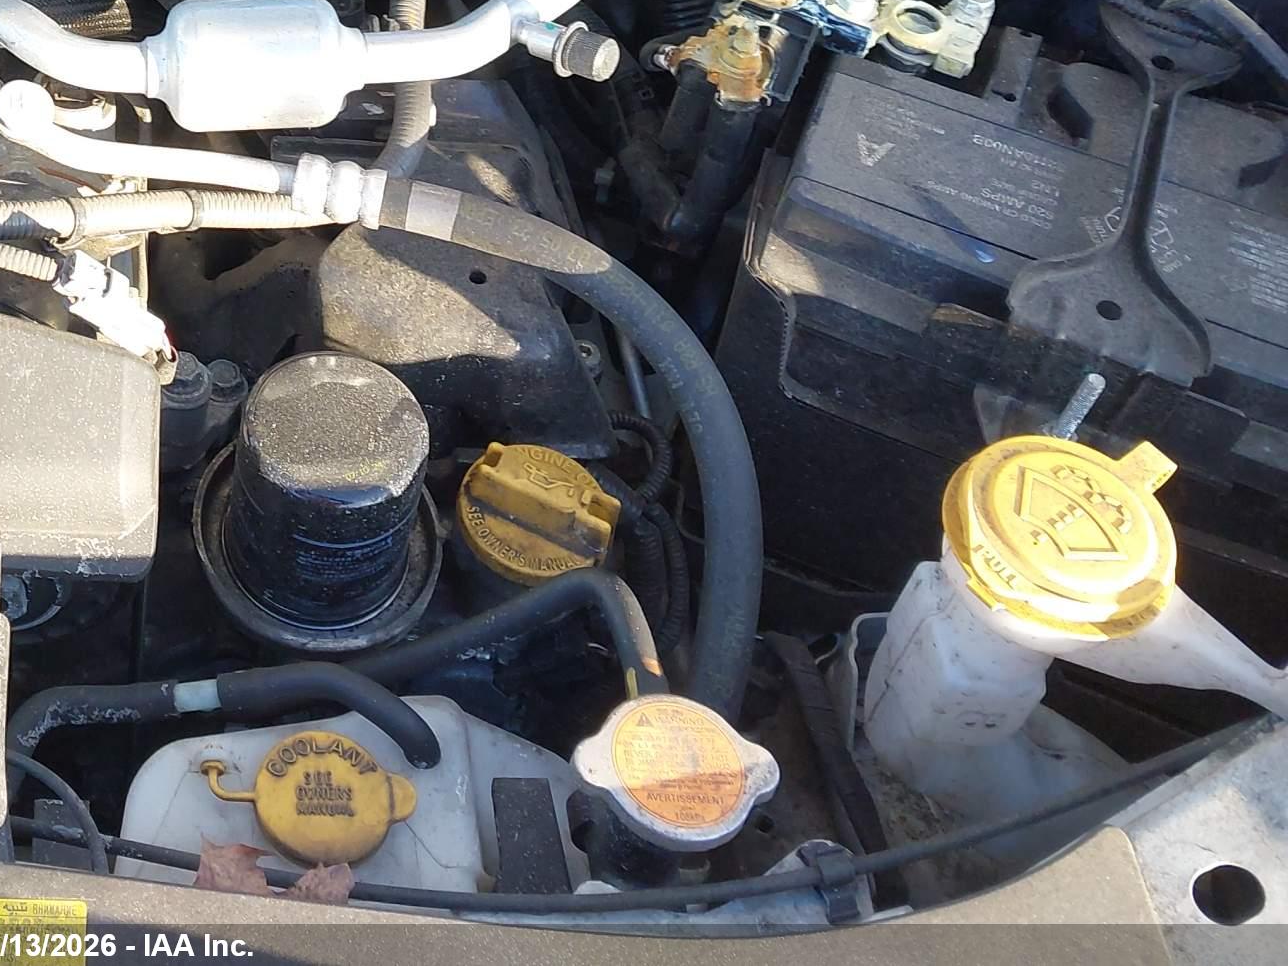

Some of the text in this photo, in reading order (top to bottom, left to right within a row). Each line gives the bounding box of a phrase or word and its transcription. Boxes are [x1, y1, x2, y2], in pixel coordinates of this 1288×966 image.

[465, 505, 488, 528] SEE
[478, 528, 527, 567] OWNER'S
[265, 737, 379, 778] COOLANT
[303, 770, 333, 785] SEE
[646, 792, 725, 805] AVERTISSEMENT
